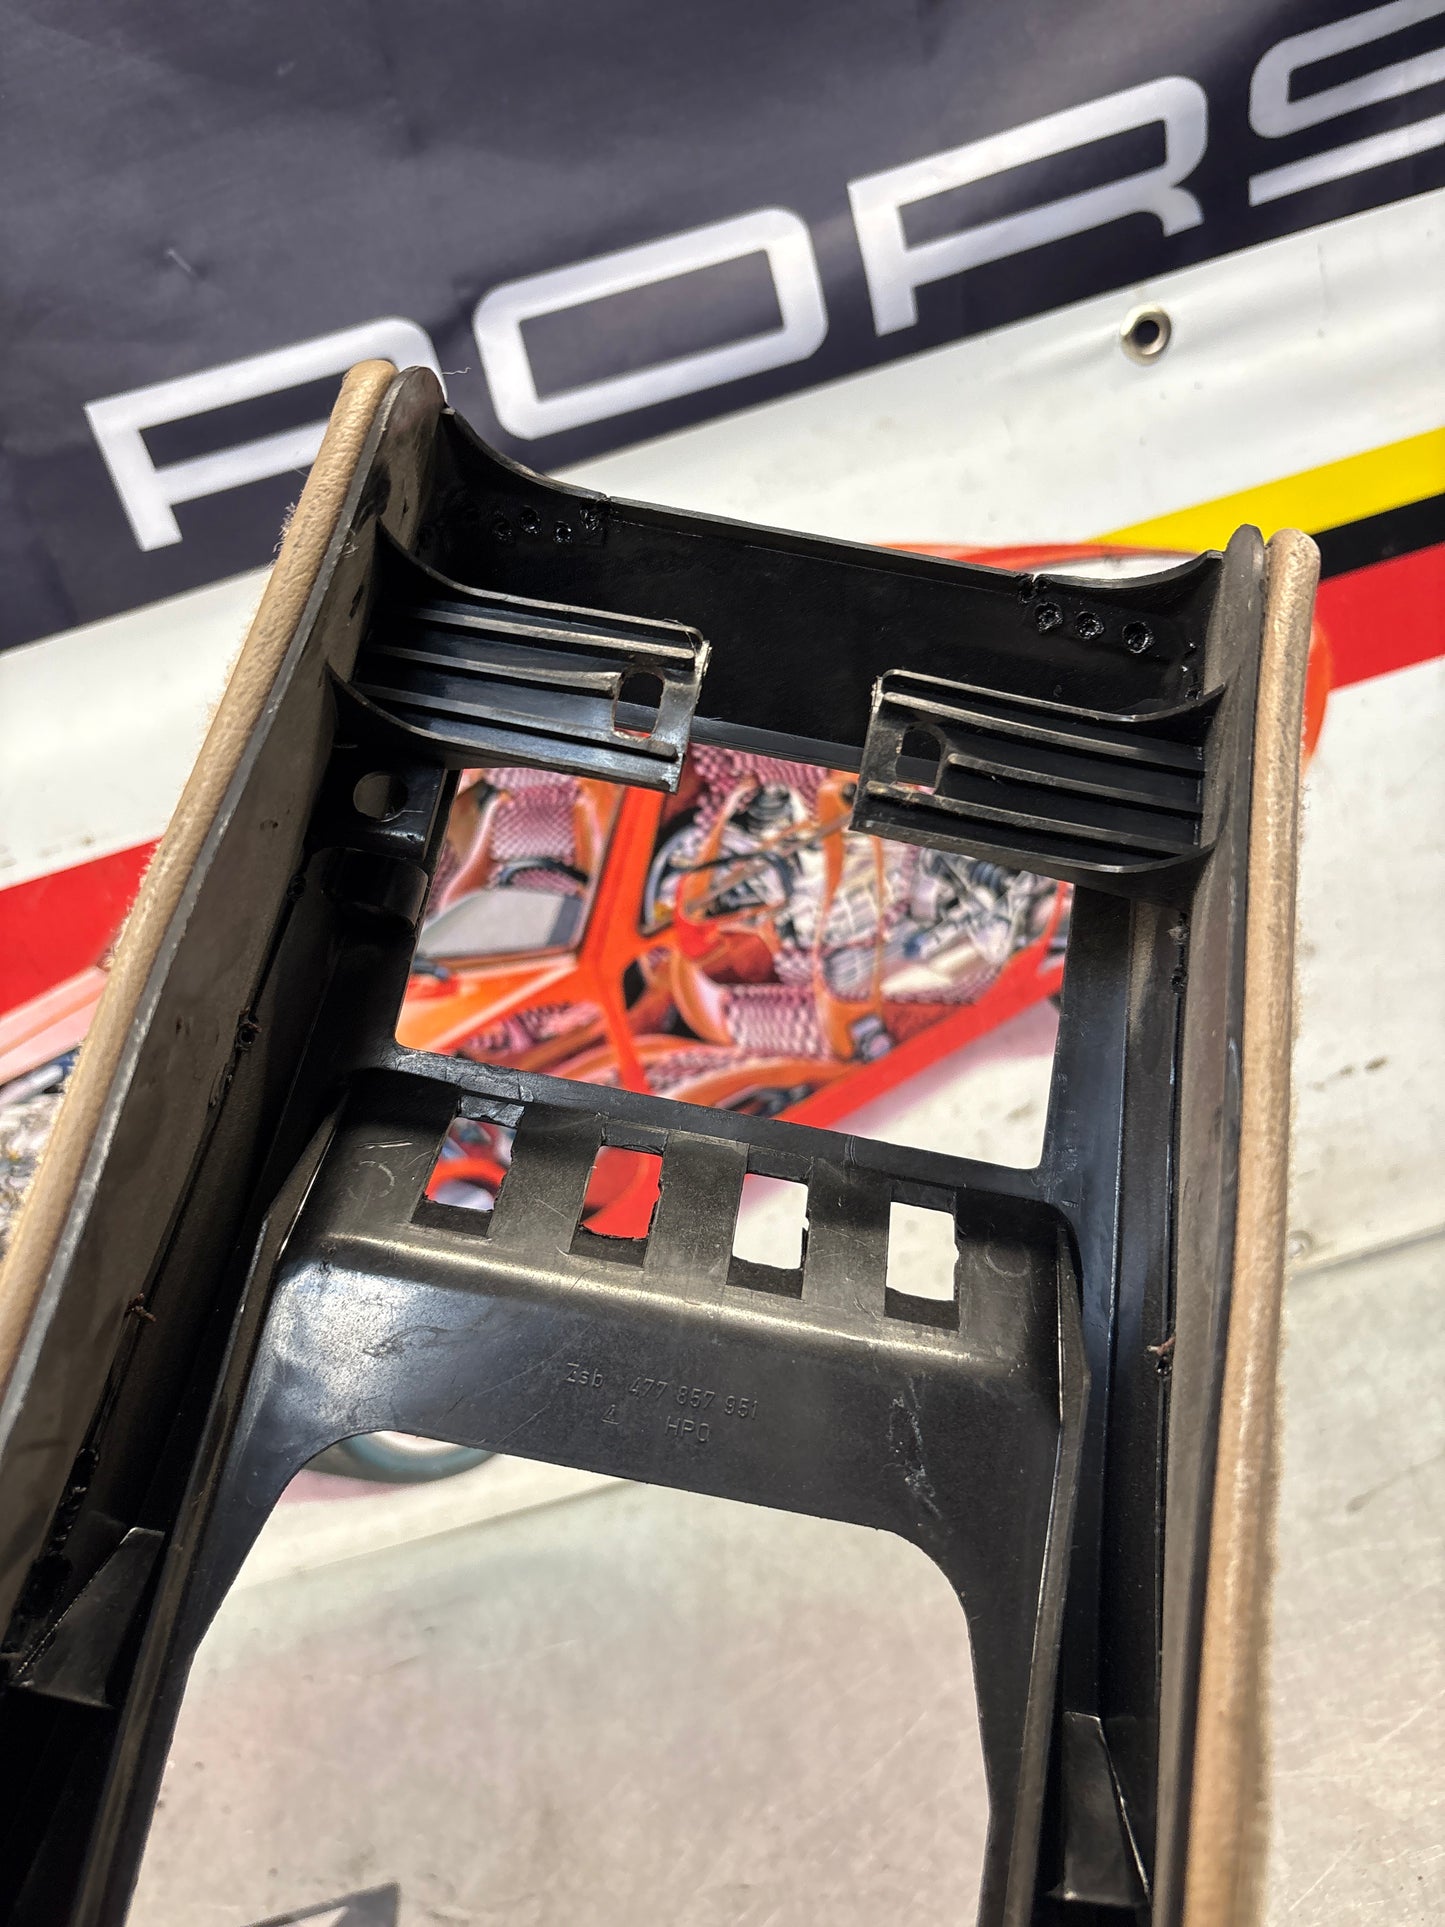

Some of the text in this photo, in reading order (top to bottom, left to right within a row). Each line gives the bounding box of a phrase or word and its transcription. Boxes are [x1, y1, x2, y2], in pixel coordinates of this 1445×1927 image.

[565, 1362, 758, 1418] Zsb 477 857 951
